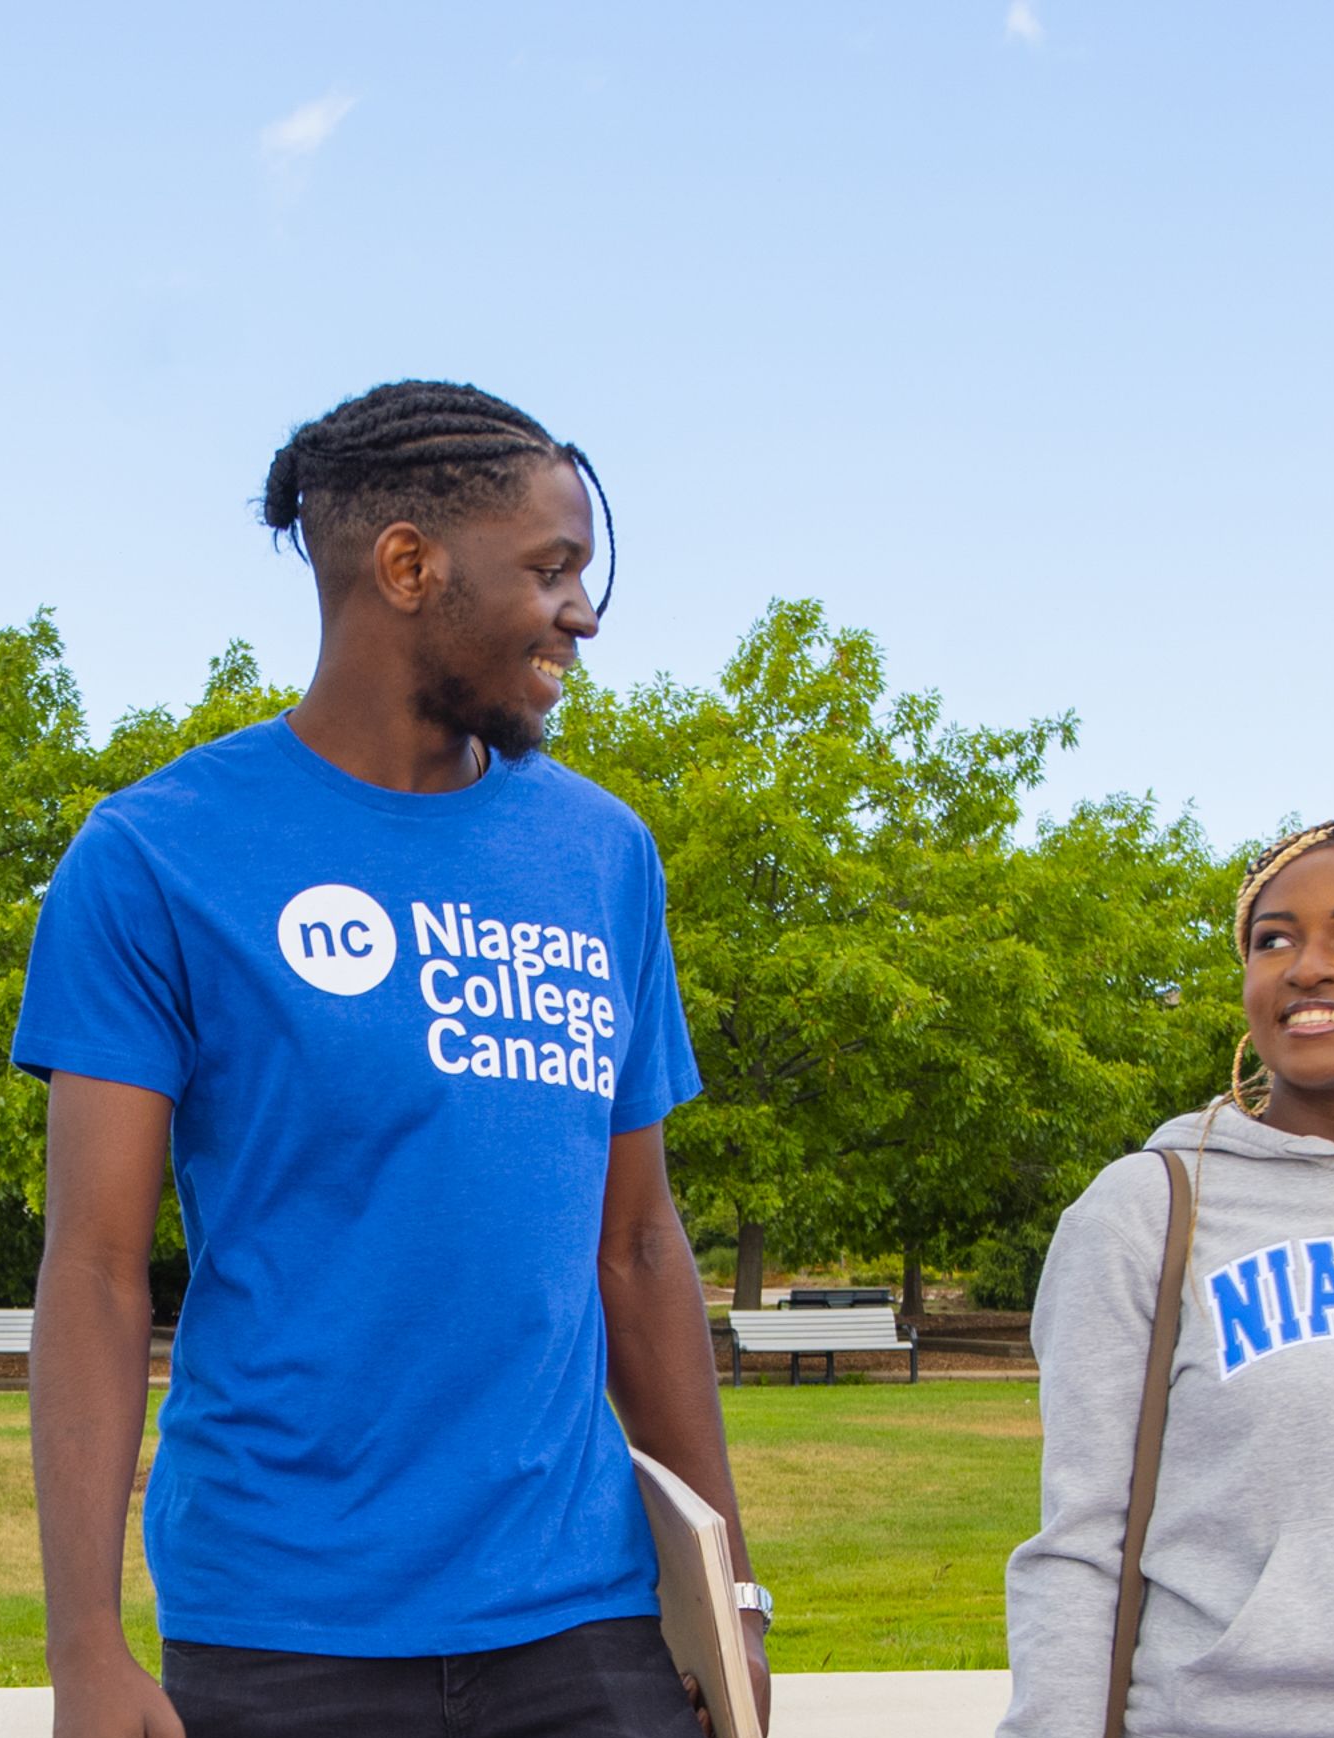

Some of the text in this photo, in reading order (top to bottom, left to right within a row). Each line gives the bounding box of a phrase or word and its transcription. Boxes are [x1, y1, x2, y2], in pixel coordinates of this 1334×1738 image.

[299, 919, 373, 958] nc
[411, 901, 609, 981] Niagara
[419, 959, 615, 1044] College
[427, 1017, 614, 1100] Canada
